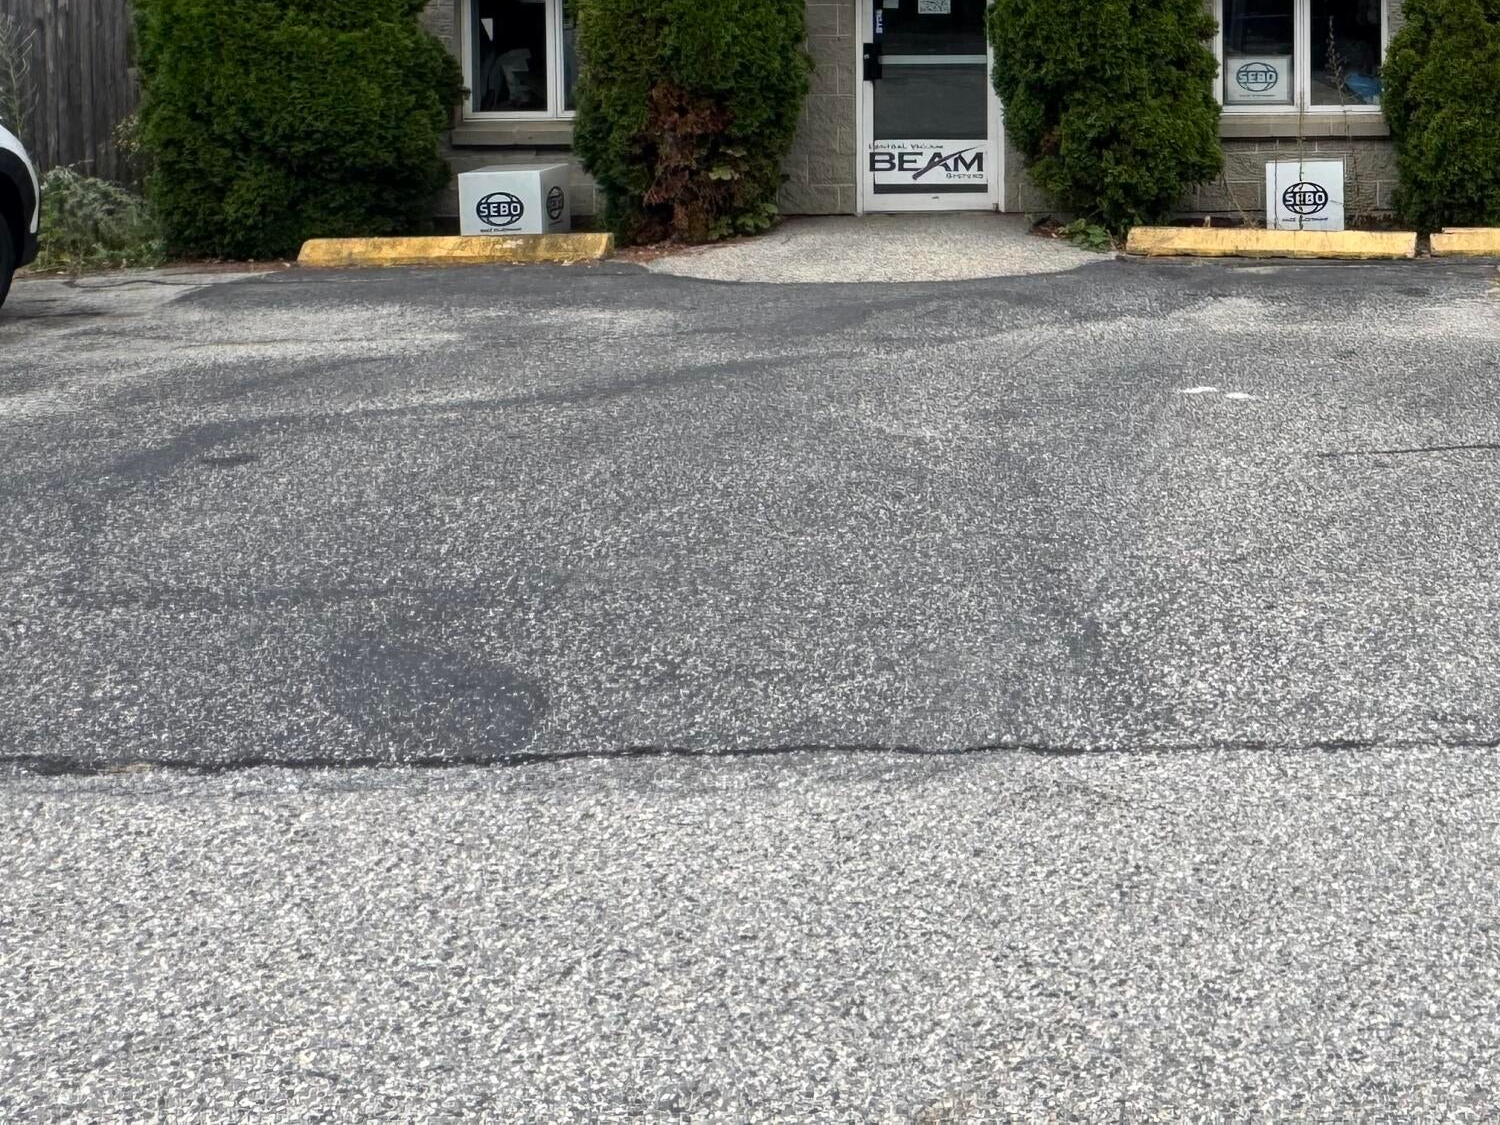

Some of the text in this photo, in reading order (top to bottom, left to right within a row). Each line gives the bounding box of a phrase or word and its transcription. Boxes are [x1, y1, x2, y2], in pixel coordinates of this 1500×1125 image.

[1239, 72, 1277, 82] SEBO
[869, 151, 984, 173] BEAM
[1285, 192, 1326, 205] SEBO
[480, 203, 520, 216] SEBO
